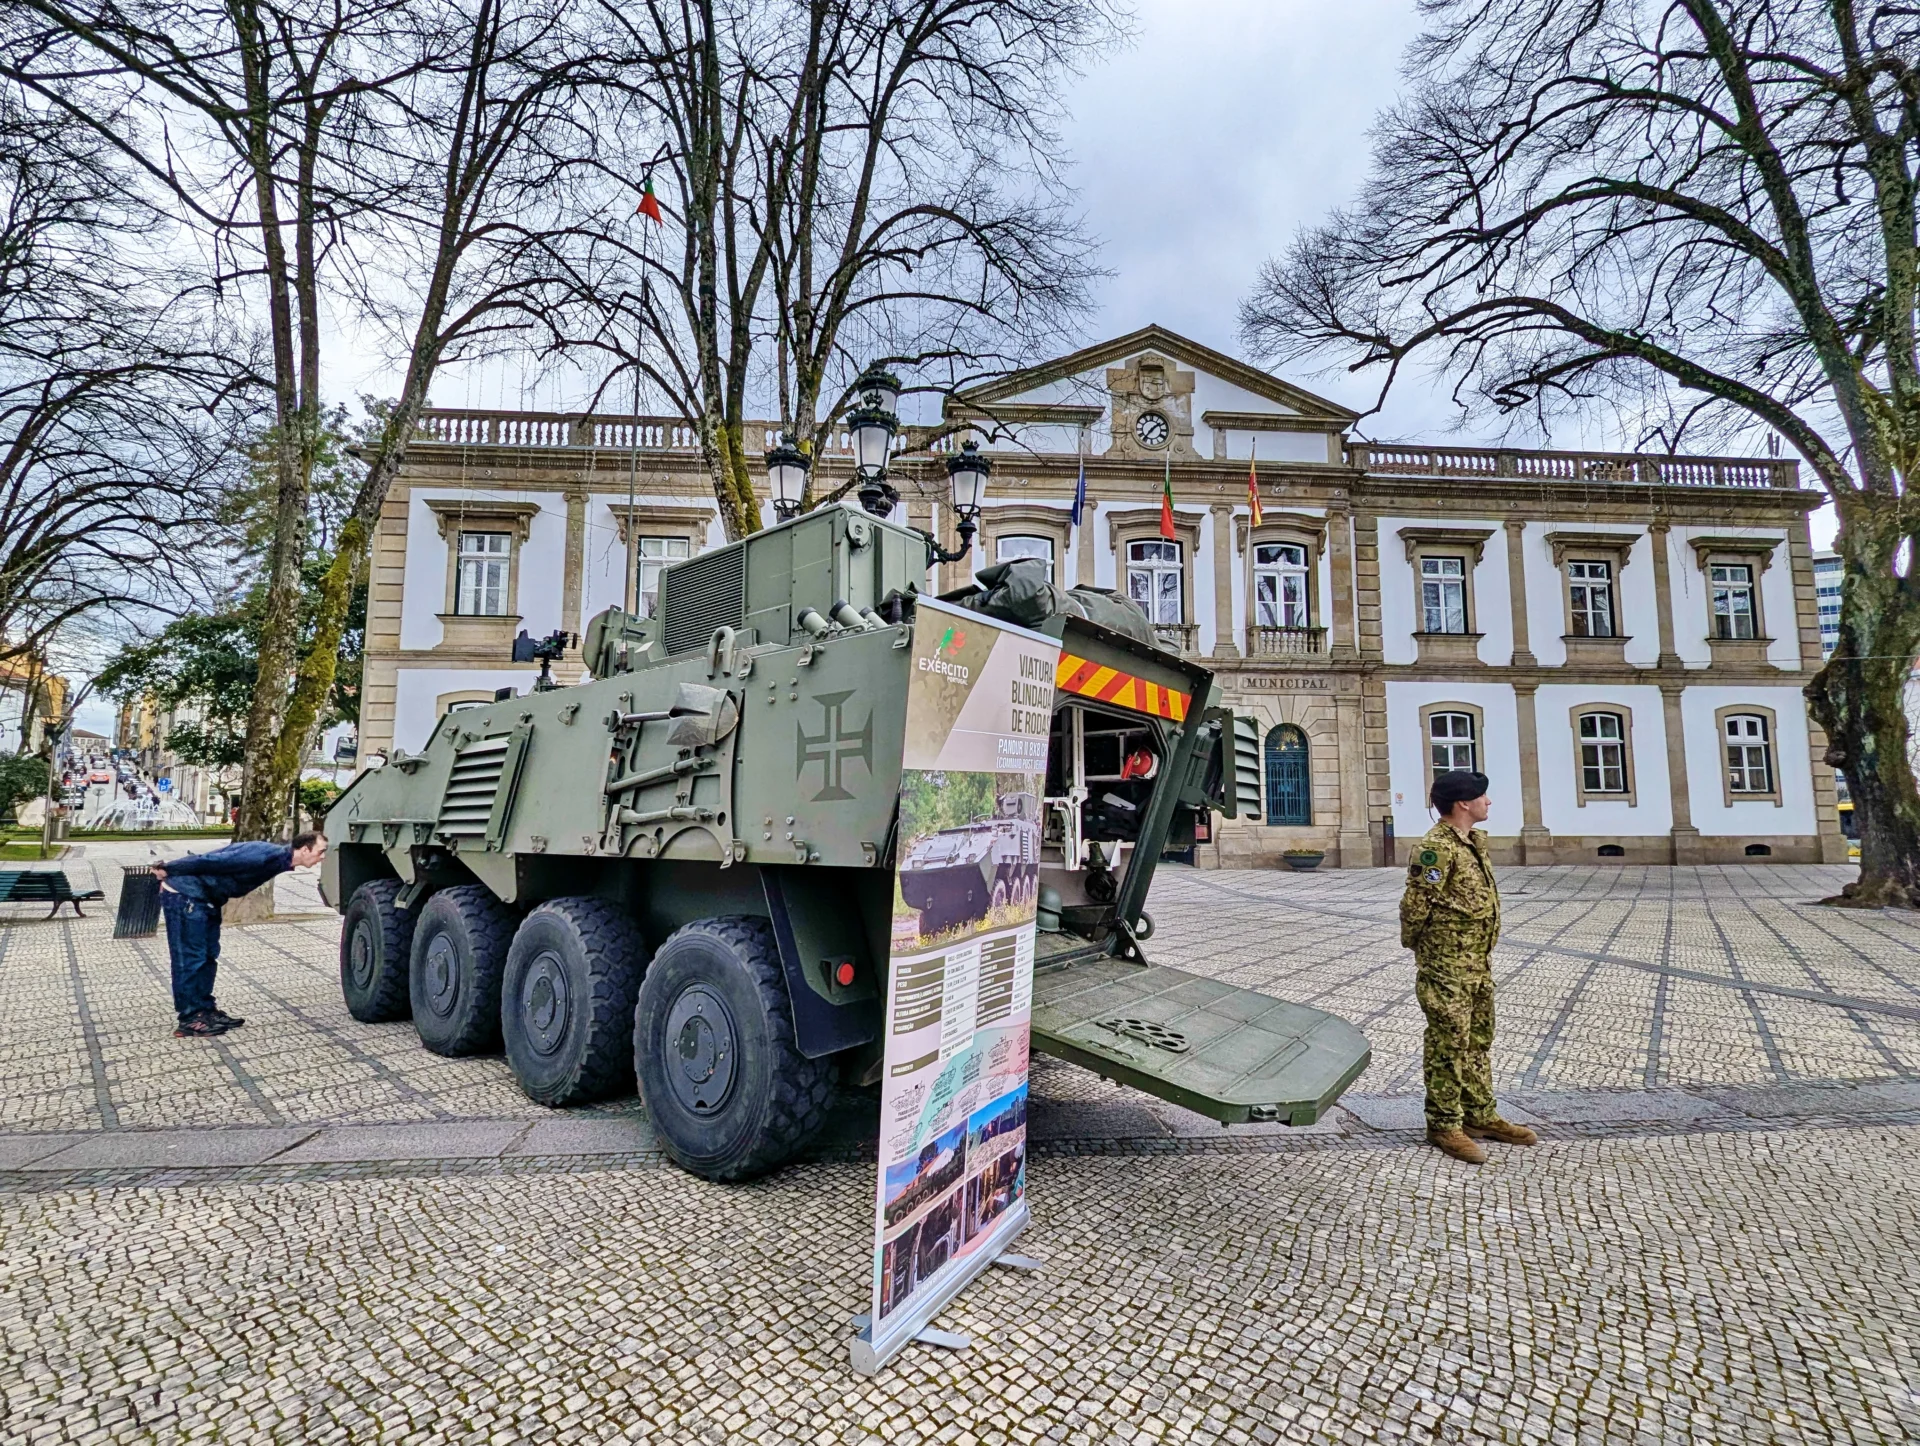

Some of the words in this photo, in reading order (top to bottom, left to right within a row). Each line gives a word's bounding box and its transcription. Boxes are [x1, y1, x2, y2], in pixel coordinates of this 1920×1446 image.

[919, 657, 969, 679] EXÉRCITO
[1019, 653, 1053, 685] VIATURA
[1011, 680, 1052, 711] BLINDADA
[1246, 677, 1328, 689] MUNICIPAL
[1011, 708, 1023, 733] DE
[1025, 711, 1050, 736] RODAS
